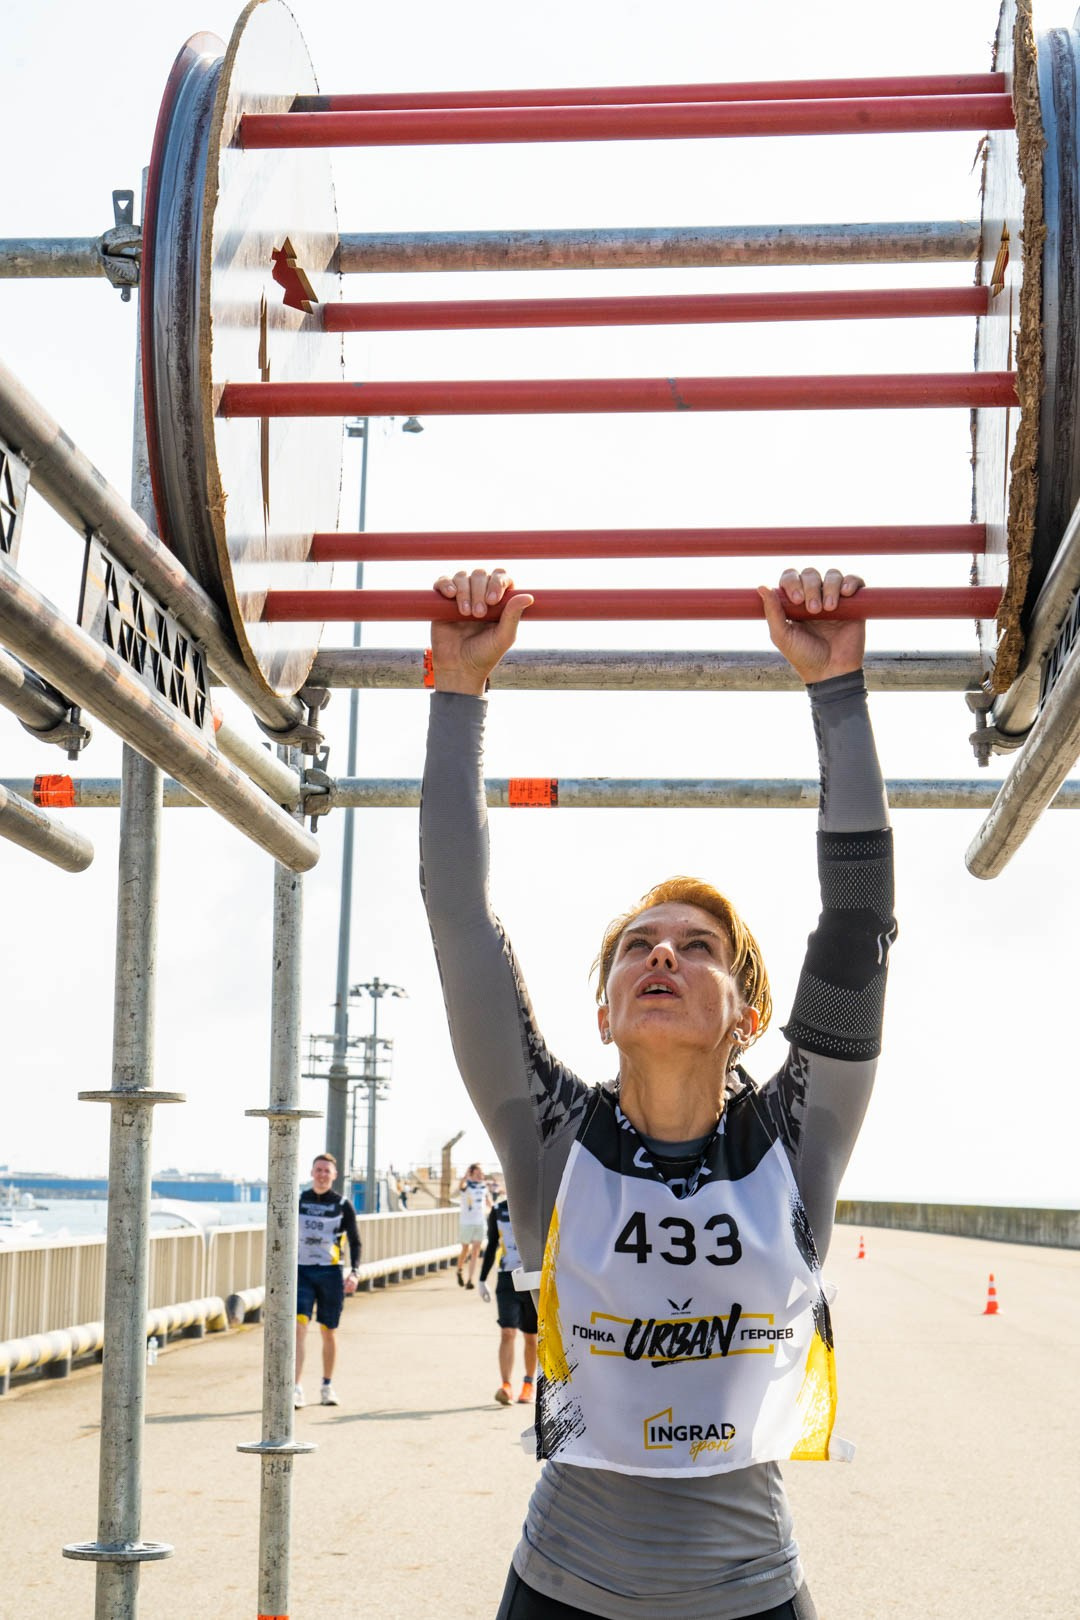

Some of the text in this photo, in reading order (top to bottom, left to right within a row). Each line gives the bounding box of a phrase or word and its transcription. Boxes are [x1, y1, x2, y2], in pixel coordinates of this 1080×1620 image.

[614, 1211, 743, 1267] 433
[572, 1302, 794, 1364] ГОНКА URBAN ГЕРОЕВ
[650, 1423, 736, 1442] INGRAD
[689, 1428, 735, 1463] sport
